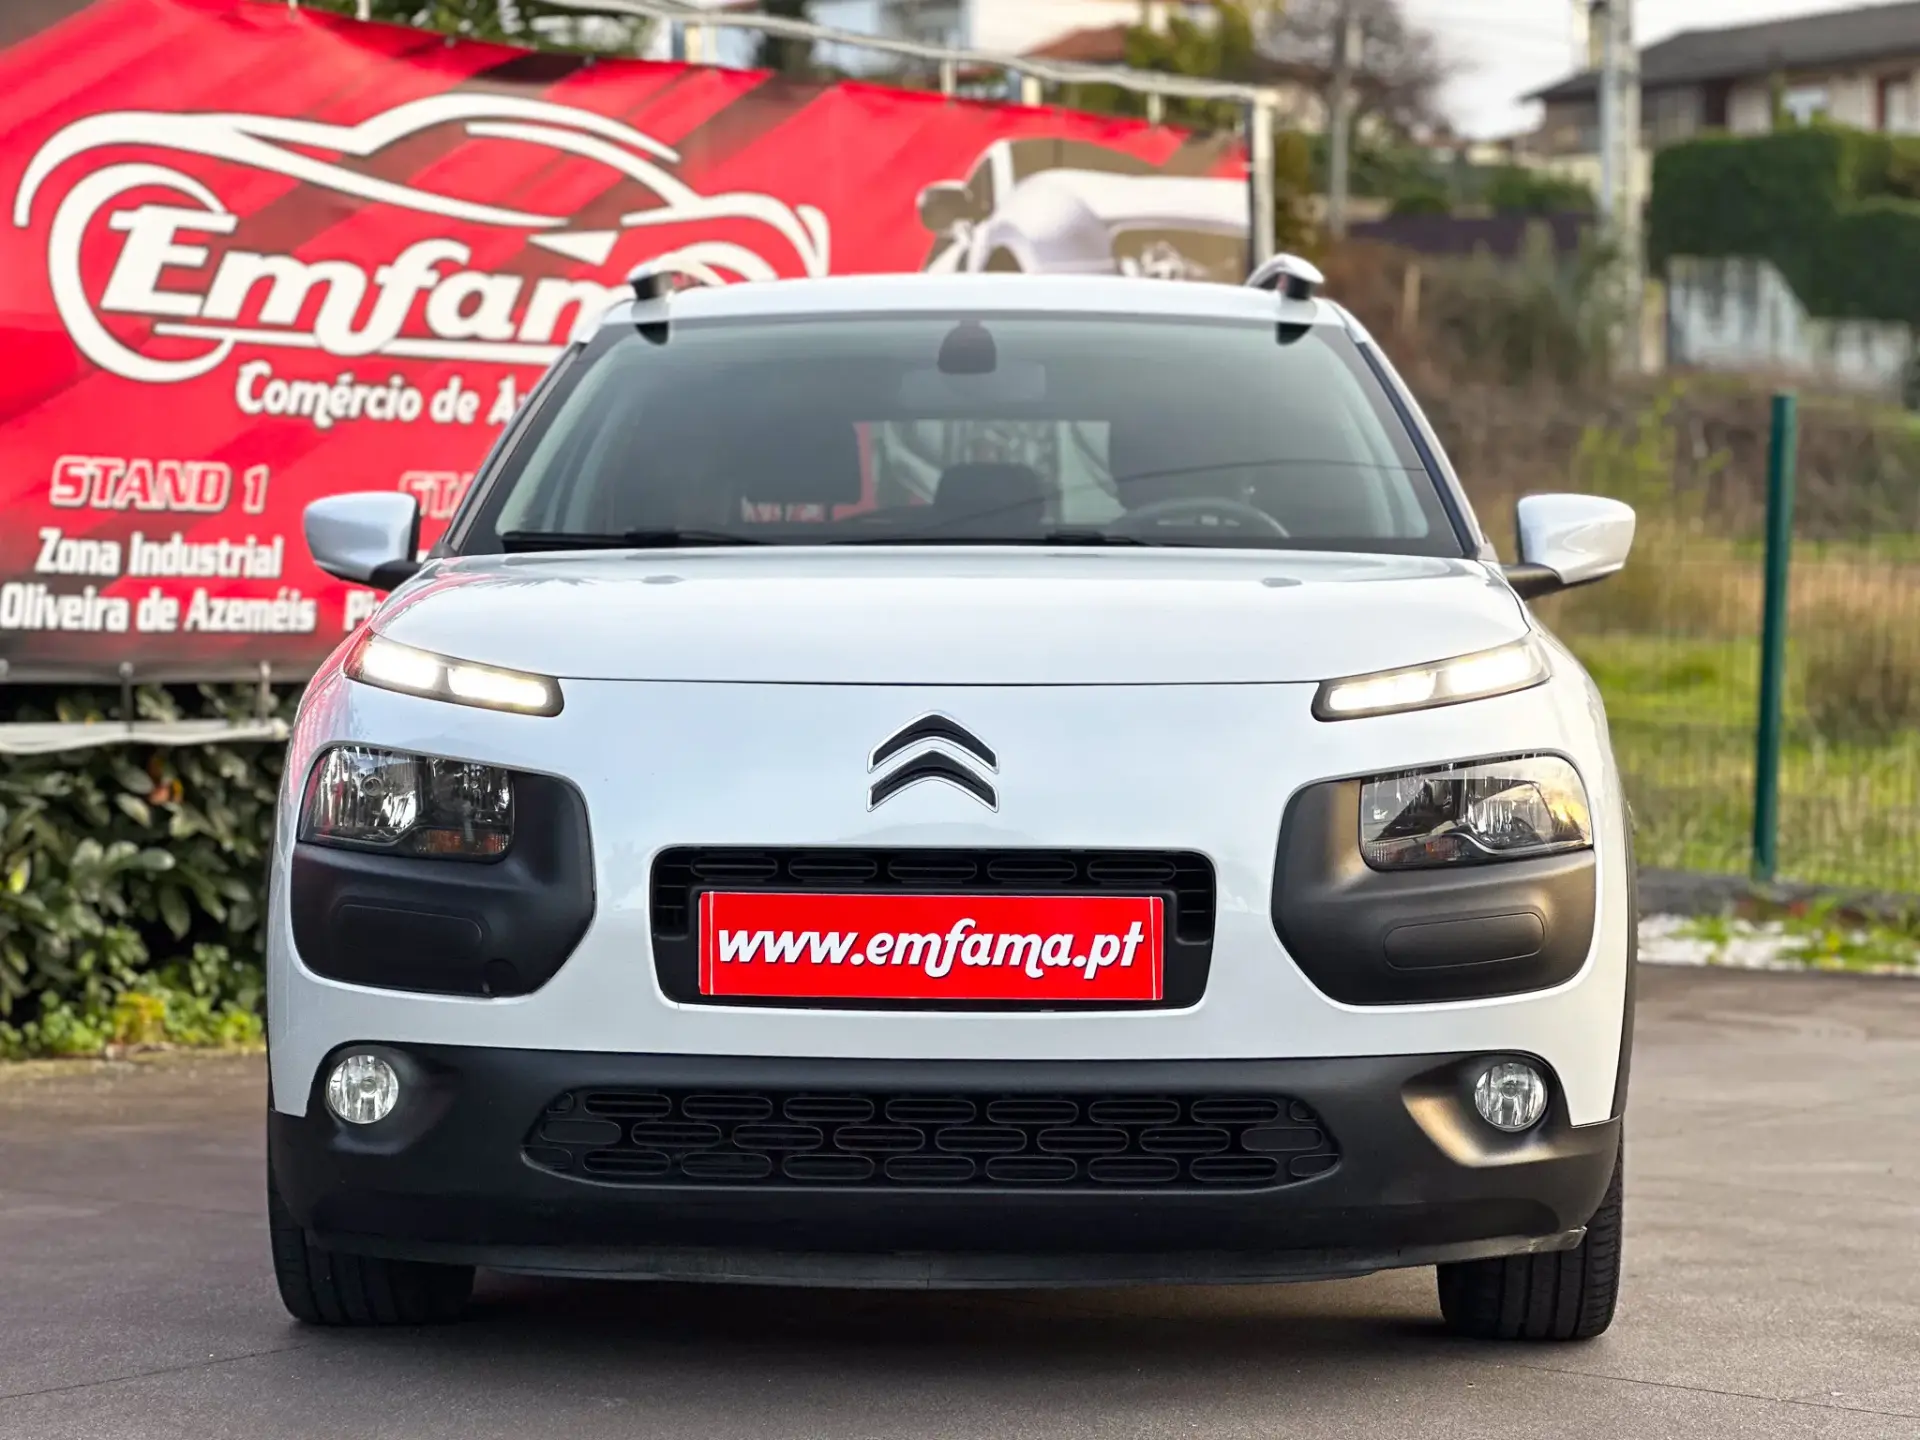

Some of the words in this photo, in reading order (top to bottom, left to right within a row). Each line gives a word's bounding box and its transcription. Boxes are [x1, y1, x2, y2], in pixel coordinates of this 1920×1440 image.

[235, 359, 424, 429] Comércio
[428, 374, 481, 426] de
[485, 372, 527, 427] A
[50, 455, 231, 513] STAND
[243, 464, 269, 514] 1
[35, 528, 120, 576] Zona
[129, 531, 284, 579] Industrial
[0, 582, 129, 633] Oliveira
[138, 588, 178, 633] de
[184, 588, 315, 634] Azeméis
[718, 918, 1145, 980] www.emfama.pt
